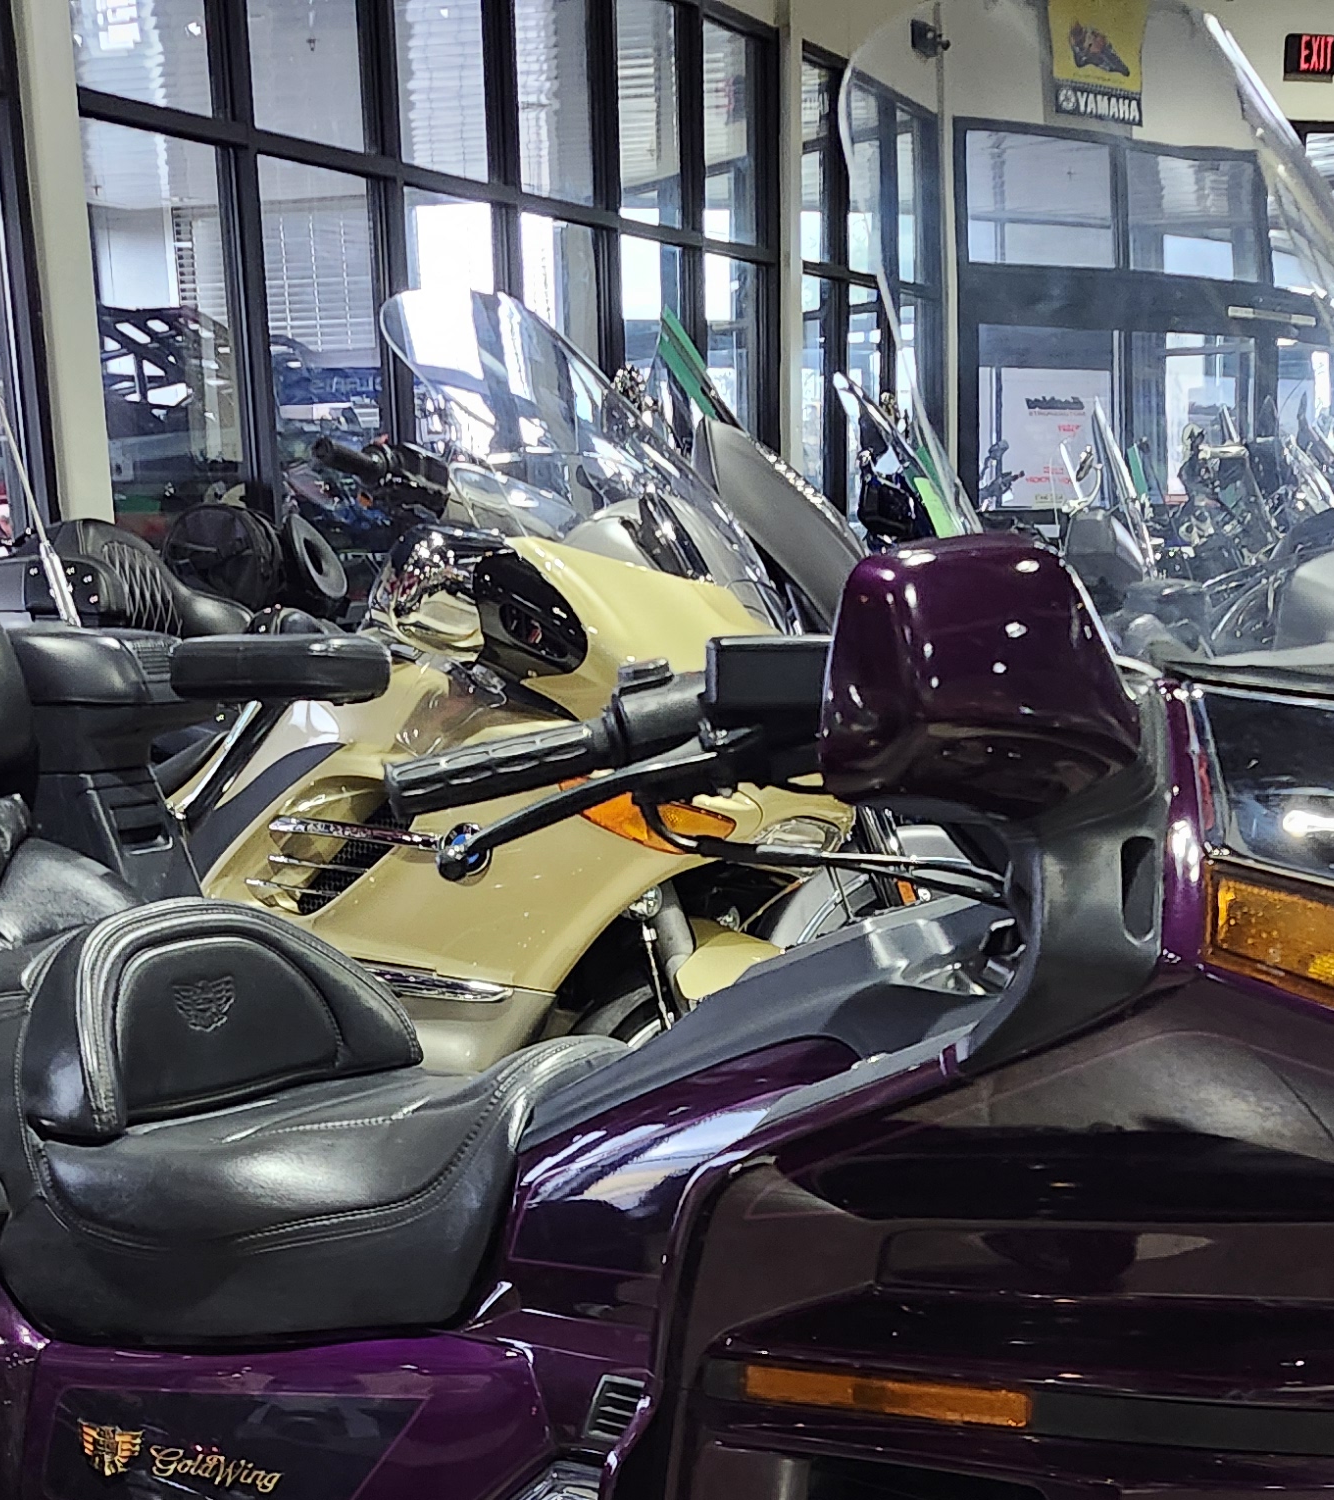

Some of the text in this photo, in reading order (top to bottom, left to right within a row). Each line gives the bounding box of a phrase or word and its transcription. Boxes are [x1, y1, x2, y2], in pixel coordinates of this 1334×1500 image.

[1299, 35, 1334, 72] EXIT
[1076, 90, 1140, 123] YAMAHA
[149, 1444, 284, 1493] GoldWing
